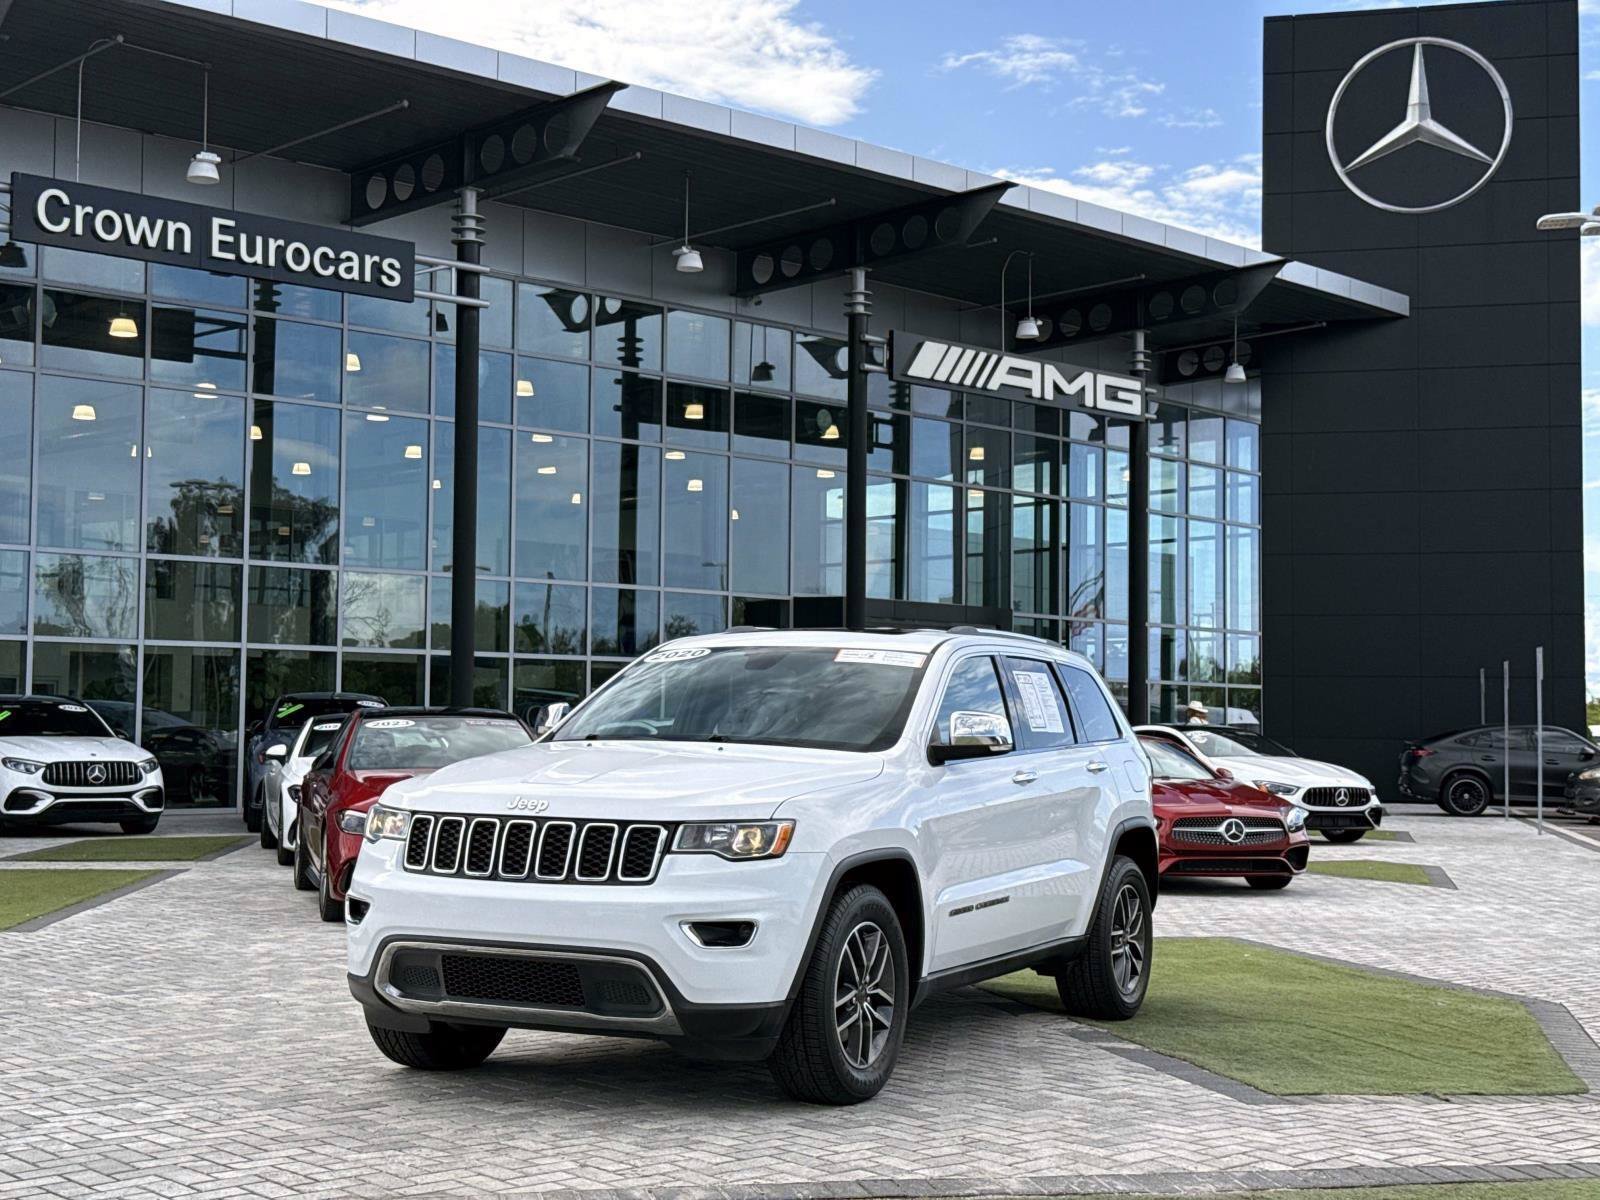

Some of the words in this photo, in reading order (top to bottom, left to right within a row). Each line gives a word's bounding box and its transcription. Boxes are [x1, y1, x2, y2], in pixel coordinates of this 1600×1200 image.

[36, 188, 192, 254] Crown
[209, 216, 402, 288] Eurocars
[986, 355, 1142, 416] AMG
[650, 650, 706, 660] 2020
[507, 796, 549, 813] Jeep
